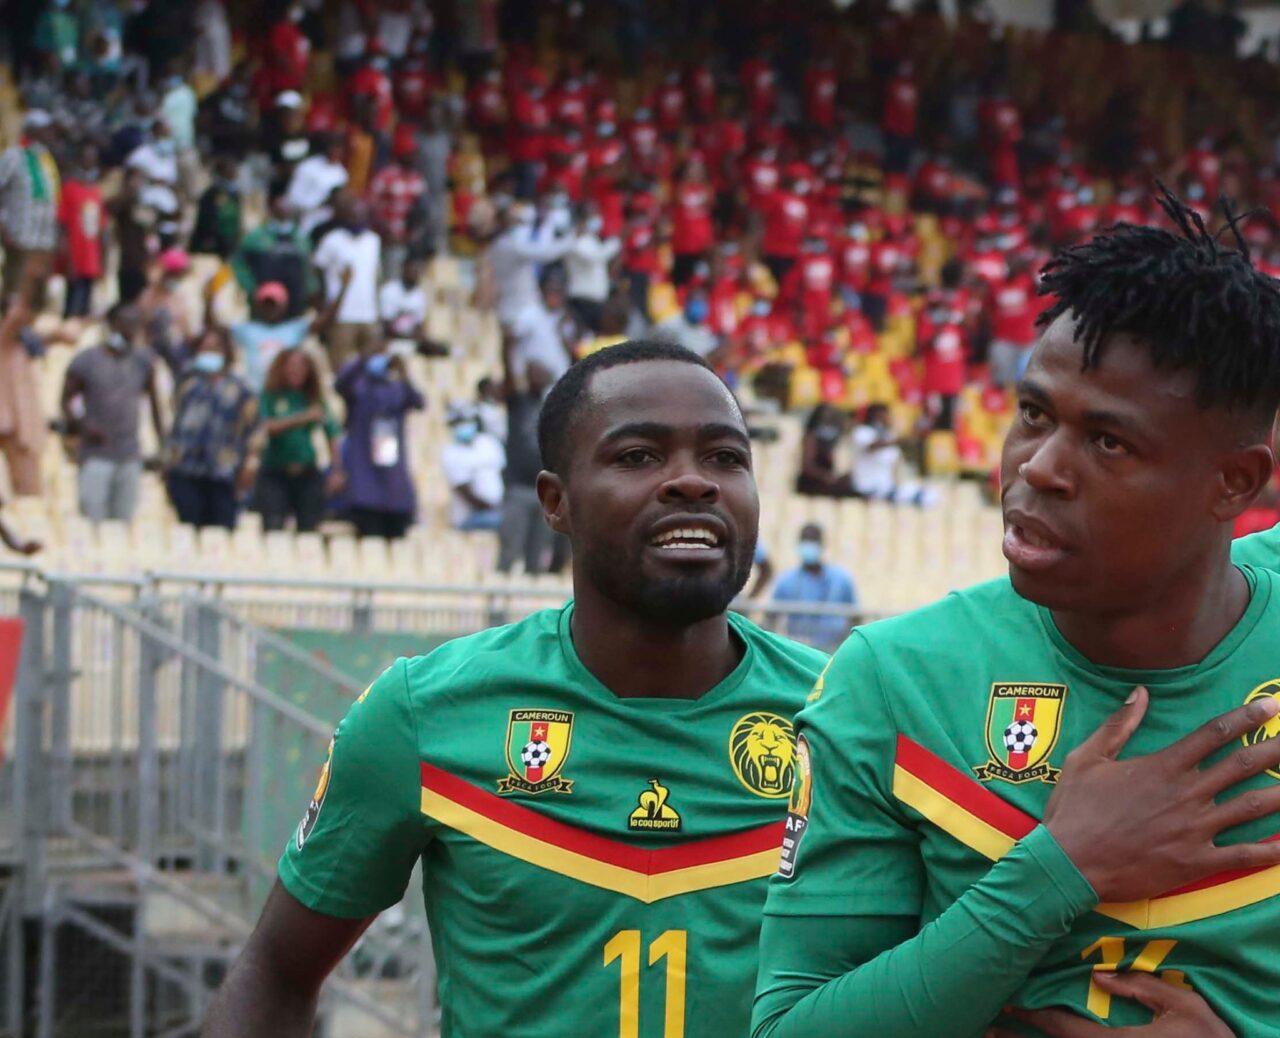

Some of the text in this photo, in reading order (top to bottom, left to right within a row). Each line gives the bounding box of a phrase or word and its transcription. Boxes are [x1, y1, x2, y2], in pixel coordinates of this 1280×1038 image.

[998, 686, 1060, 697] CAMEROUN
[515, 711, 569, 722] CAMEROUN
[990, 766, 1045, 780] FECA FOOT
[630, 818, 680, 829] le coq sportif
